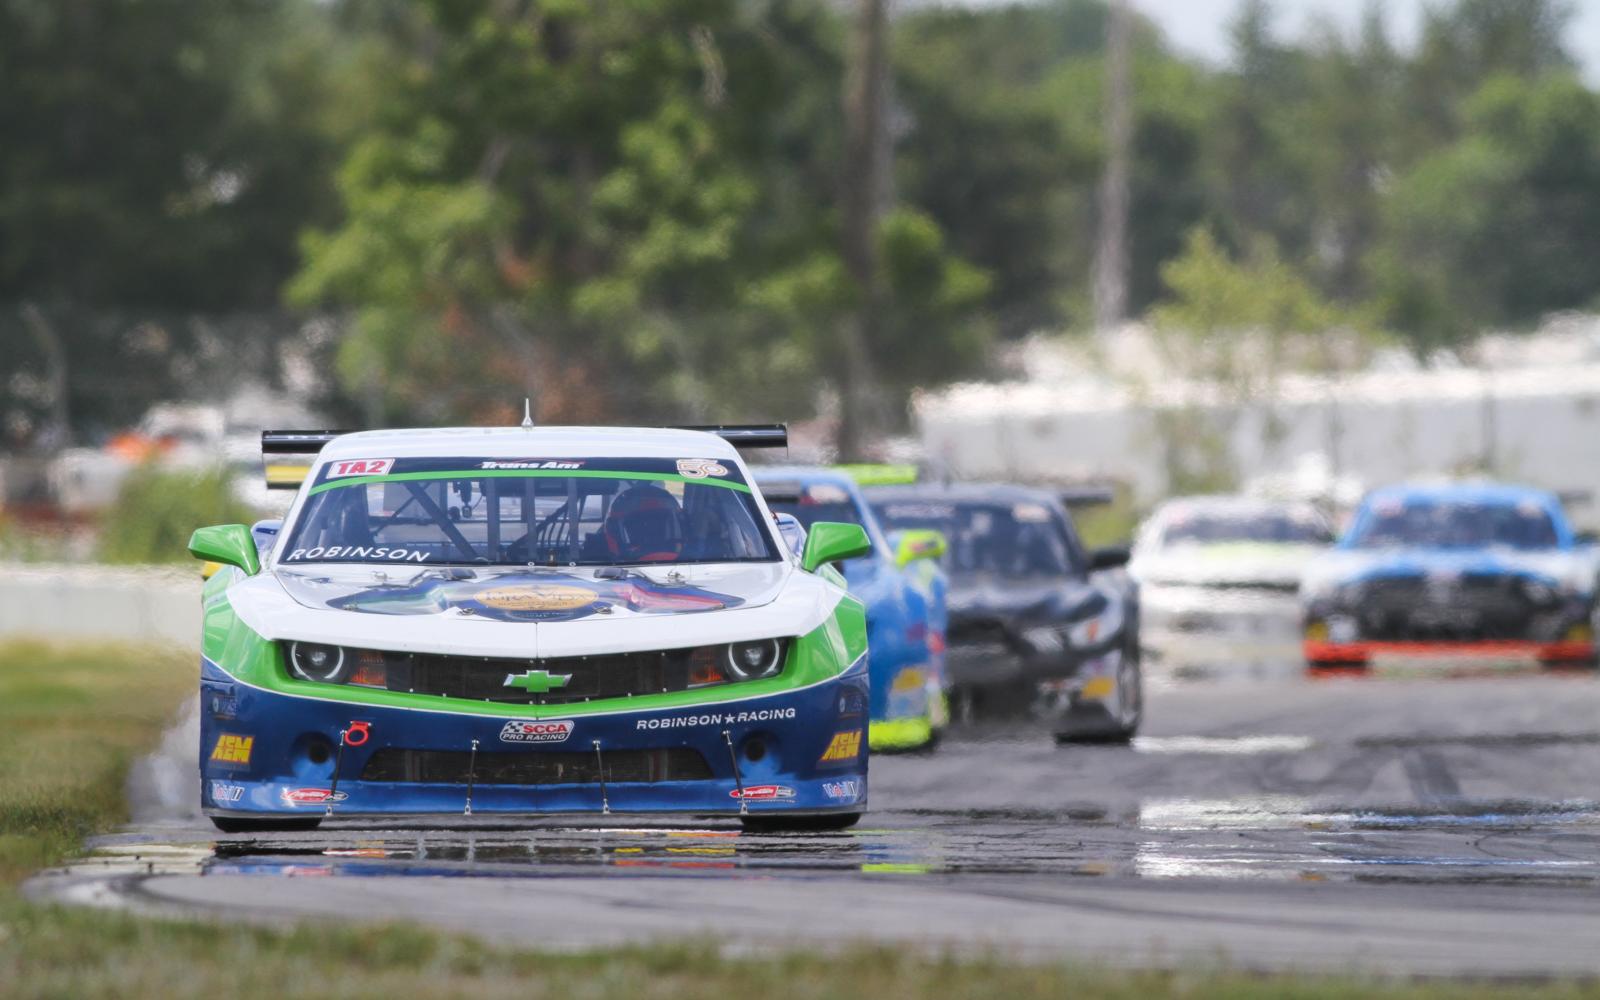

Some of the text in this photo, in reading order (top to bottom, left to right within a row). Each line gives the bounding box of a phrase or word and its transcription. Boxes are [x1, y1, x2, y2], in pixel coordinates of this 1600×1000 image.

[337, 460, 386, 475] TA2
[481, 461, 581, 469] Trans Am
[286, 546, 430, 562] ROBINSON
[523, 724, 567, 734] SCCA
[502, 733, 567, 741] PRO RACING
